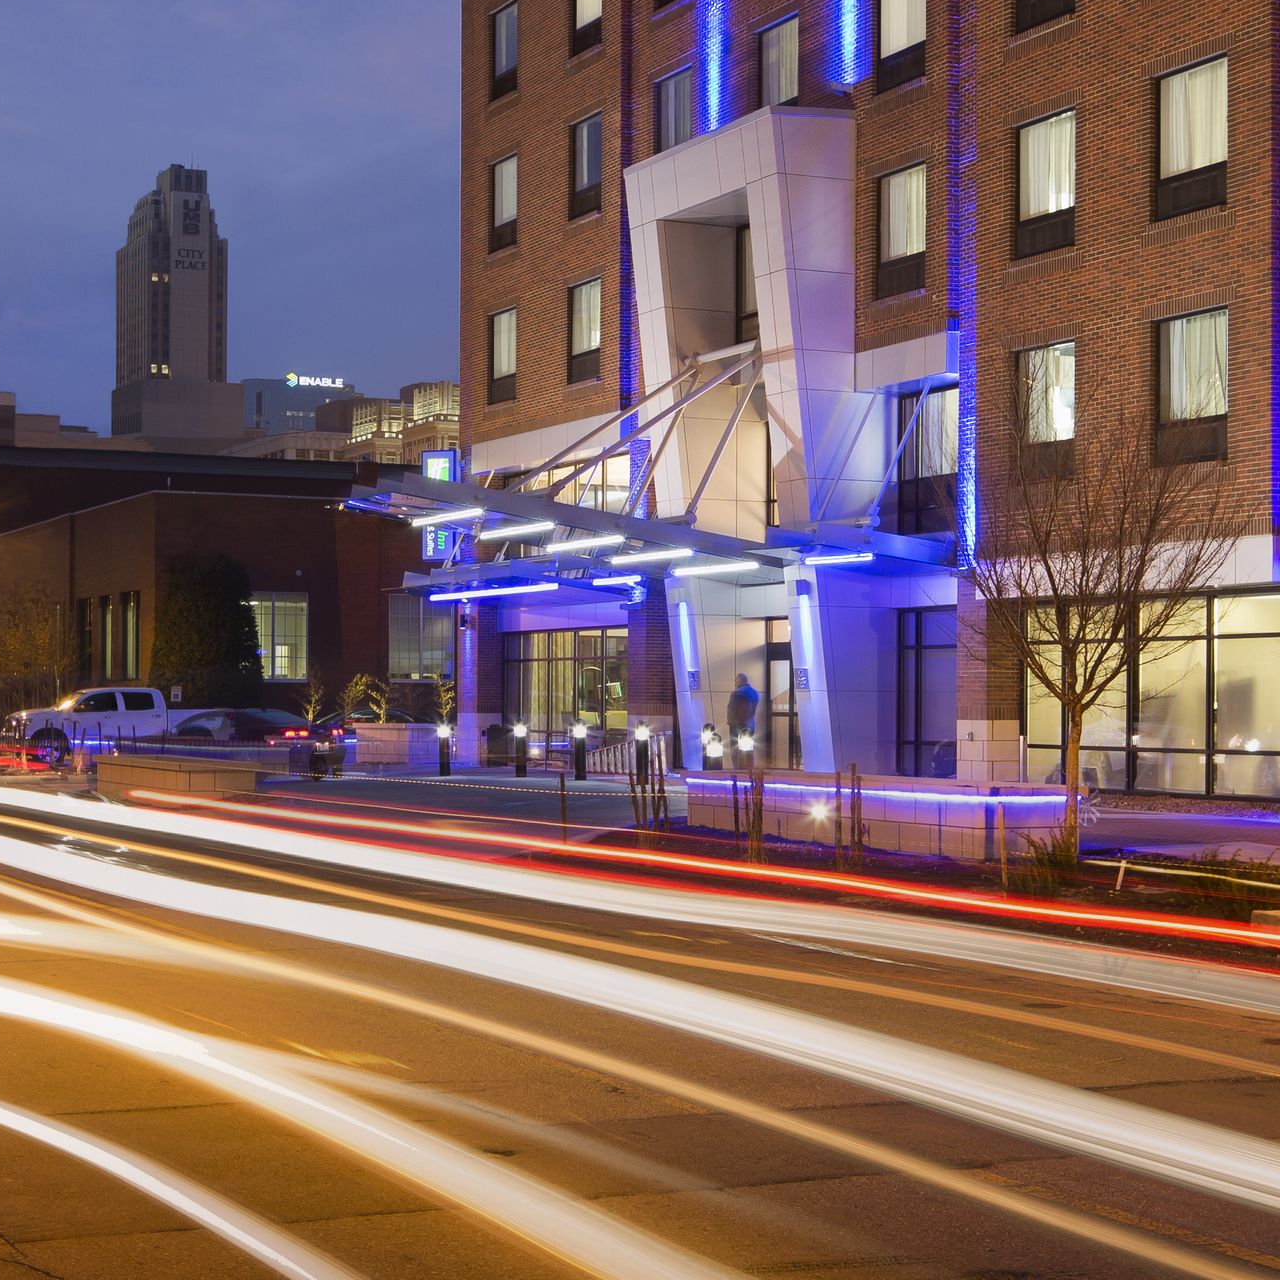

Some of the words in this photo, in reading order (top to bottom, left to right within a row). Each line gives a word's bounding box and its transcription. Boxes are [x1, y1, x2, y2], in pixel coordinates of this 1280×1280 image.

[177, 248, 206, 259] CITY
[175, 260, 208, 270] PLACE
[299, 376, 344, 388] ENABLE
